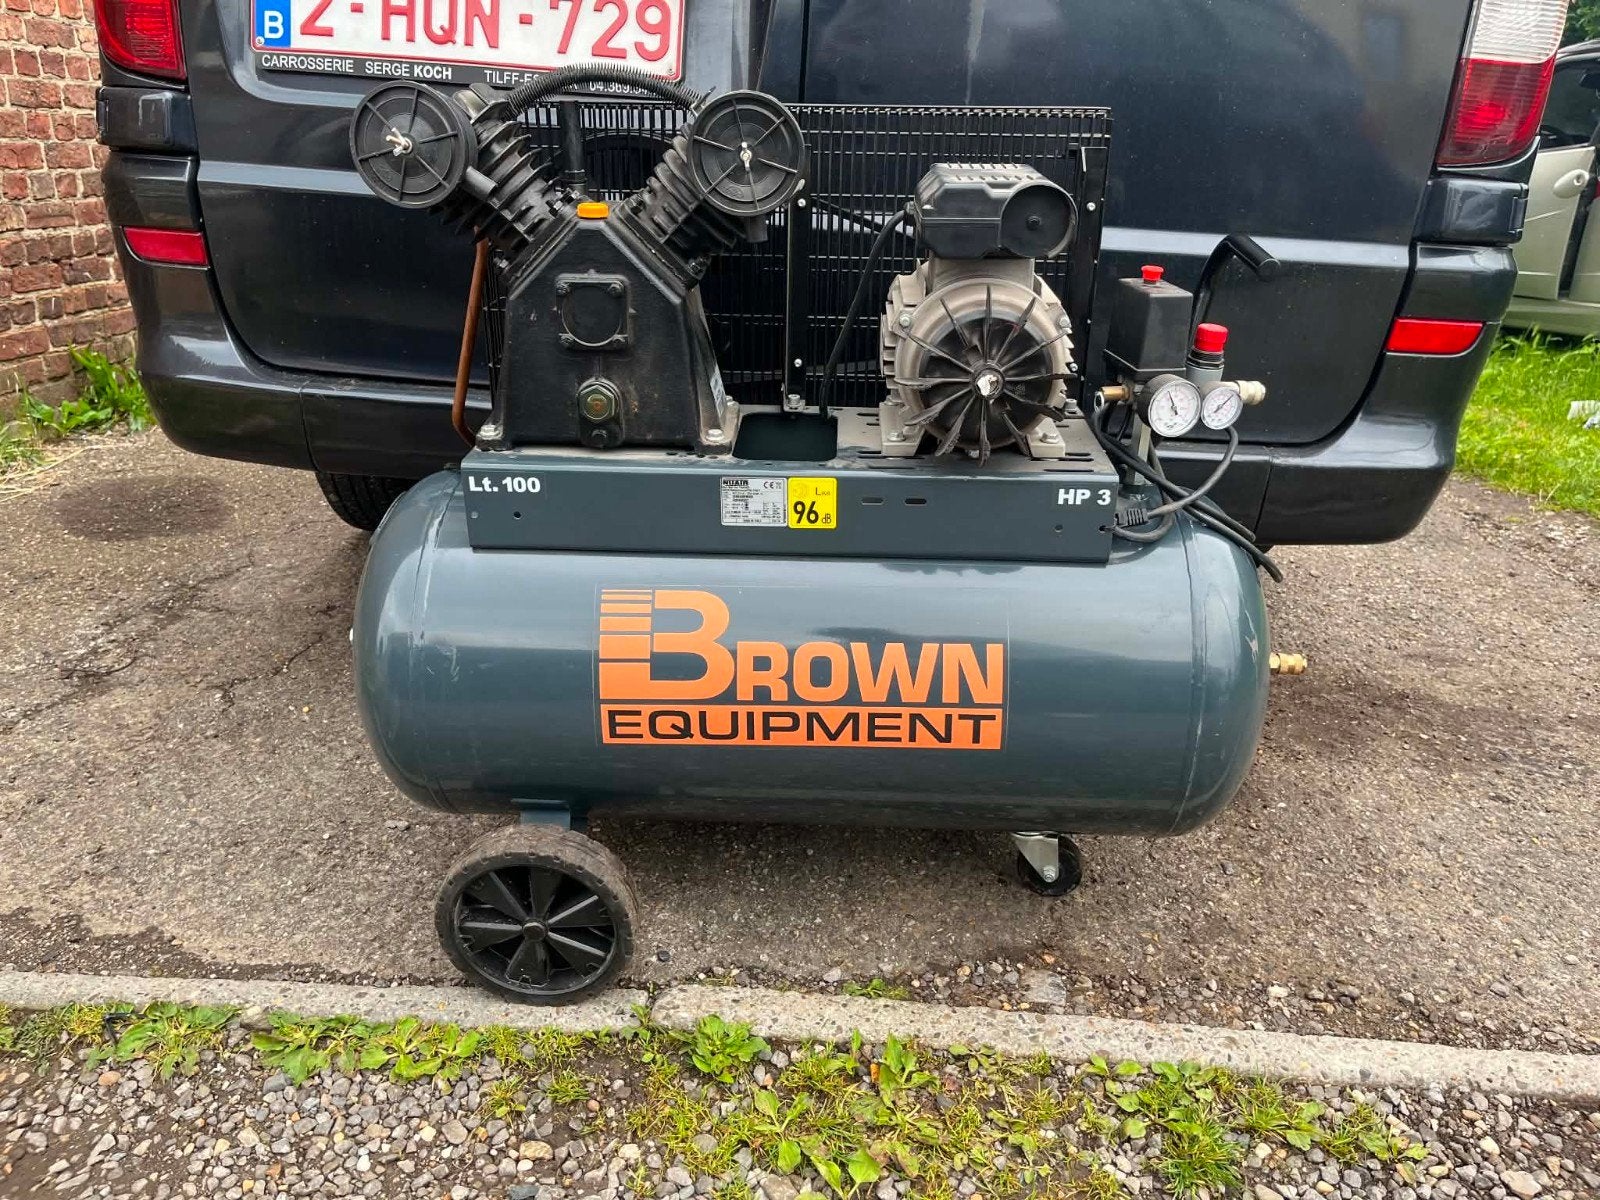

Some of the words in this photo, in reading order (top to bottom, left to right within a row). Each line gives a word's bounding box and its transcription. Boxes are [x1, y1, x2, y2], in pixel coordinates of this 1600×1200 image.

[264, 11, 284, 38] B
[262, 54, 354, 73] CARROSSERIE
[365, 61, 410, 77] SERGE
[414, 65, 452, 80] KOCH
[468, 476, 498, 492] Lt.
[502, 476, 541, 493] 100
[1058, 489, 1091, 505] HP
[1097, 489, 1111, 505] 3
[793, 501, 819, 524] 96
[822, 513, 831, 524] dB
[607, 709, 997, 744] EQUIPMENT
